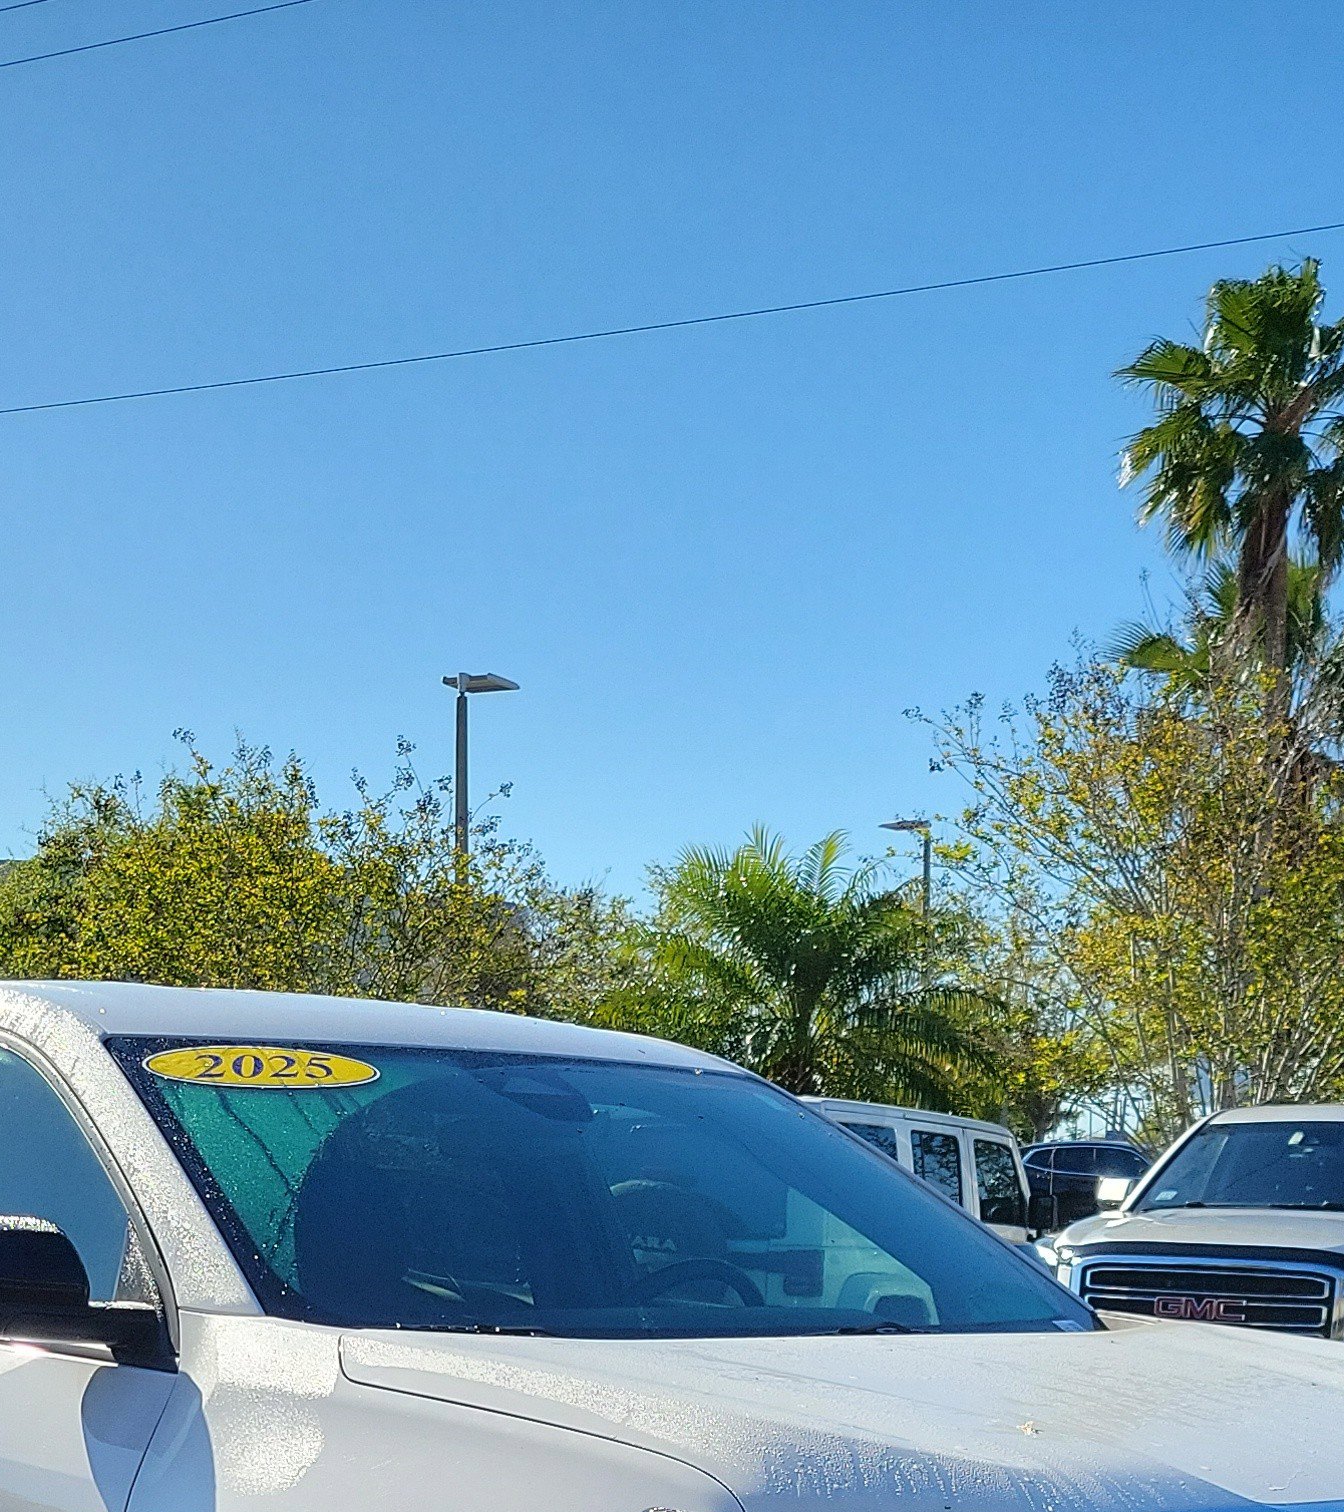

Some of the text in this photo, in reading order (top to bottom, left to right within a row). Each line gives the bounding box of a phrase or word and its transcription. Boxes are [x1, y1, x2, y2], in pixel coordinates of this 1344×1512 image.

[194, 1054, 333, 1079] 2025
[628, 1234, 677, 1252] ARA
[1154, 1296, 1247, 1321] GMC
